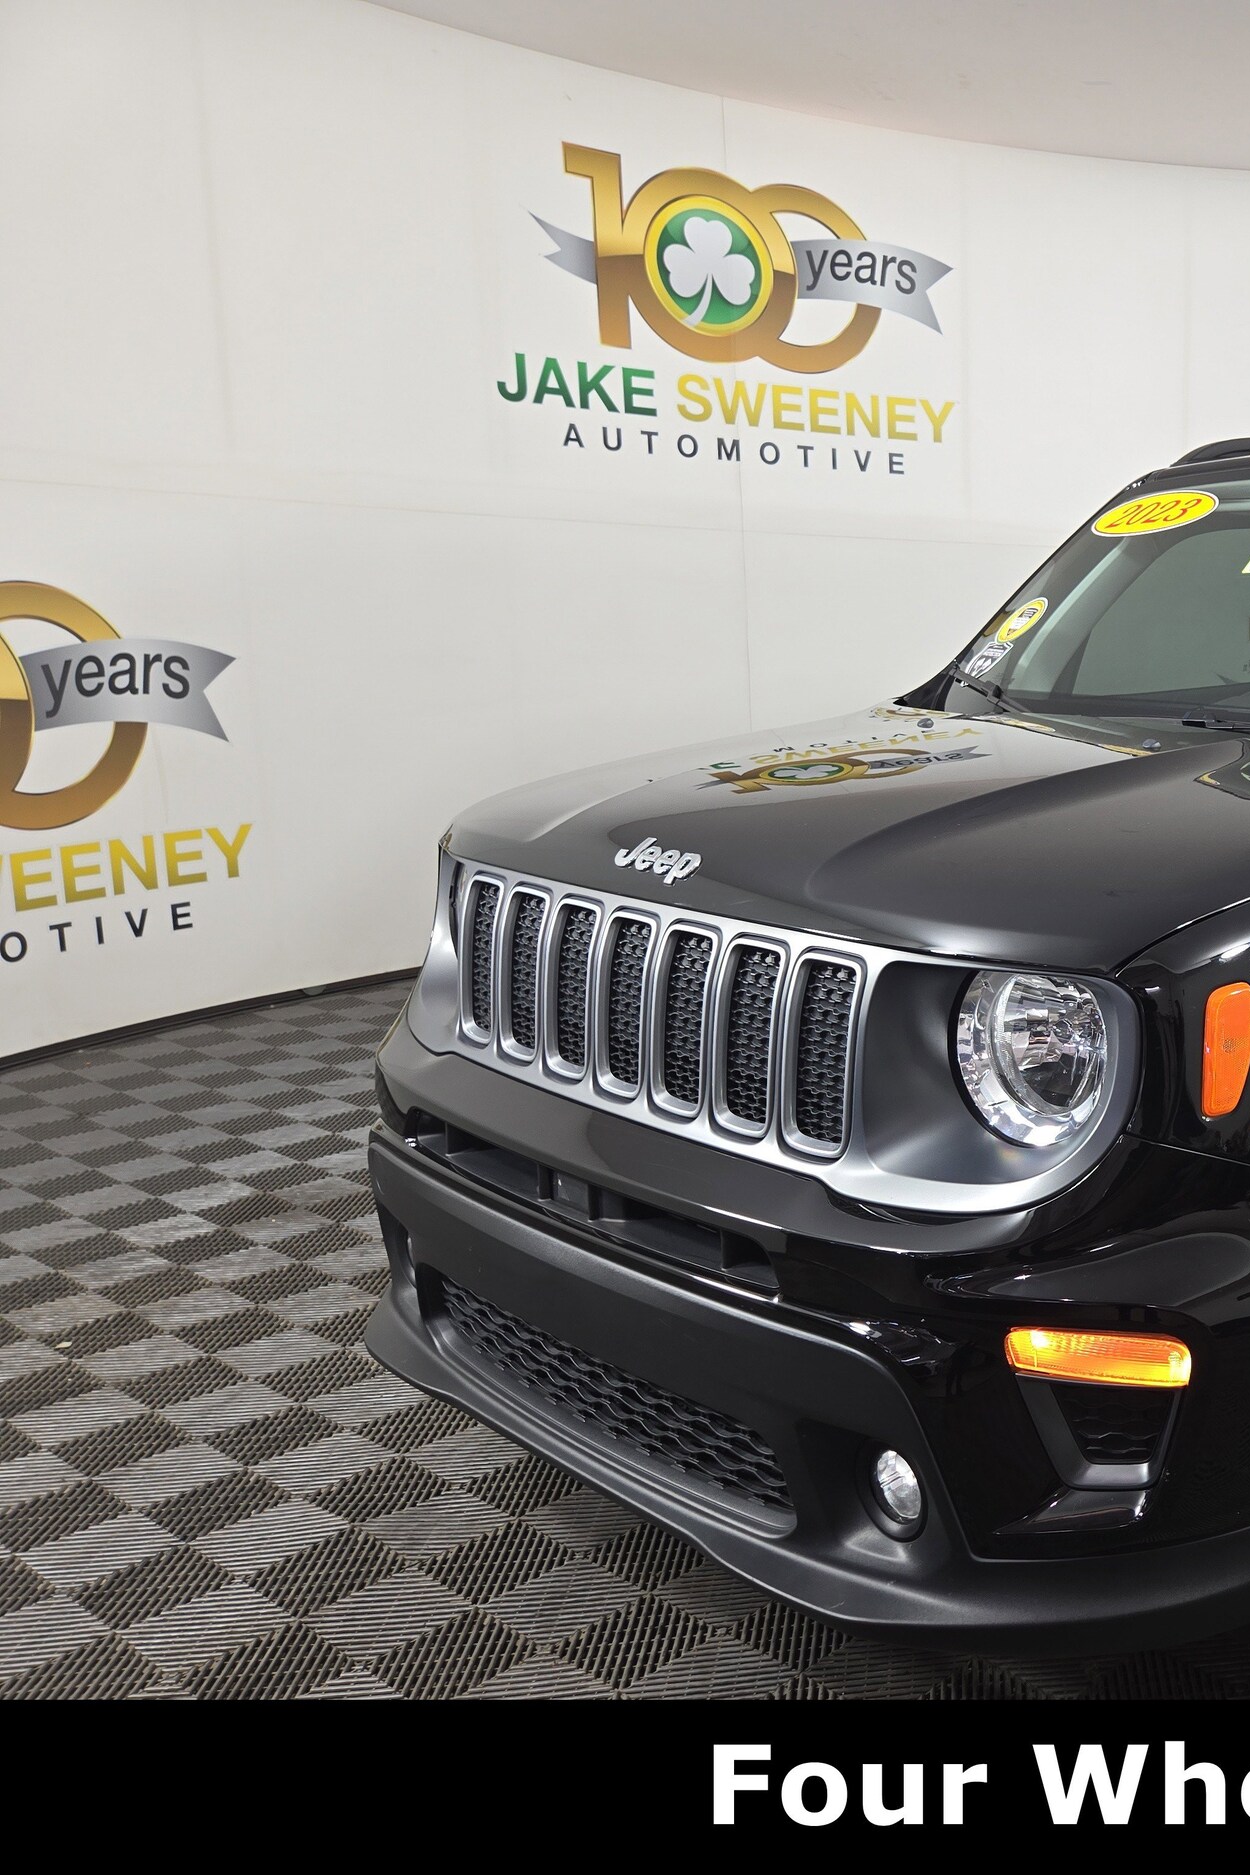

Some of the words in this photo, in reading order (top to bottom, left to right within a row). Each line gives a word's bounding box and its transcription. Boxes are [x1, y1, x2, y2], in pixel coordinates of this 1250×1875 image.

[805, 246, 917, 295] years
[497, 352, 657, 417] JAKE
[676, 374, 955, 443] SWEENEY
[563, 422, 905, 474] AUTOMOTIVE
[1109, 498, 1203, 528] 2023
[40, 652, 191, 719] years
[0, 823, 253, 912] EENEY
[613, 837, 701, 886] Jeep
[0, 902, 194, 962] OTIVE
